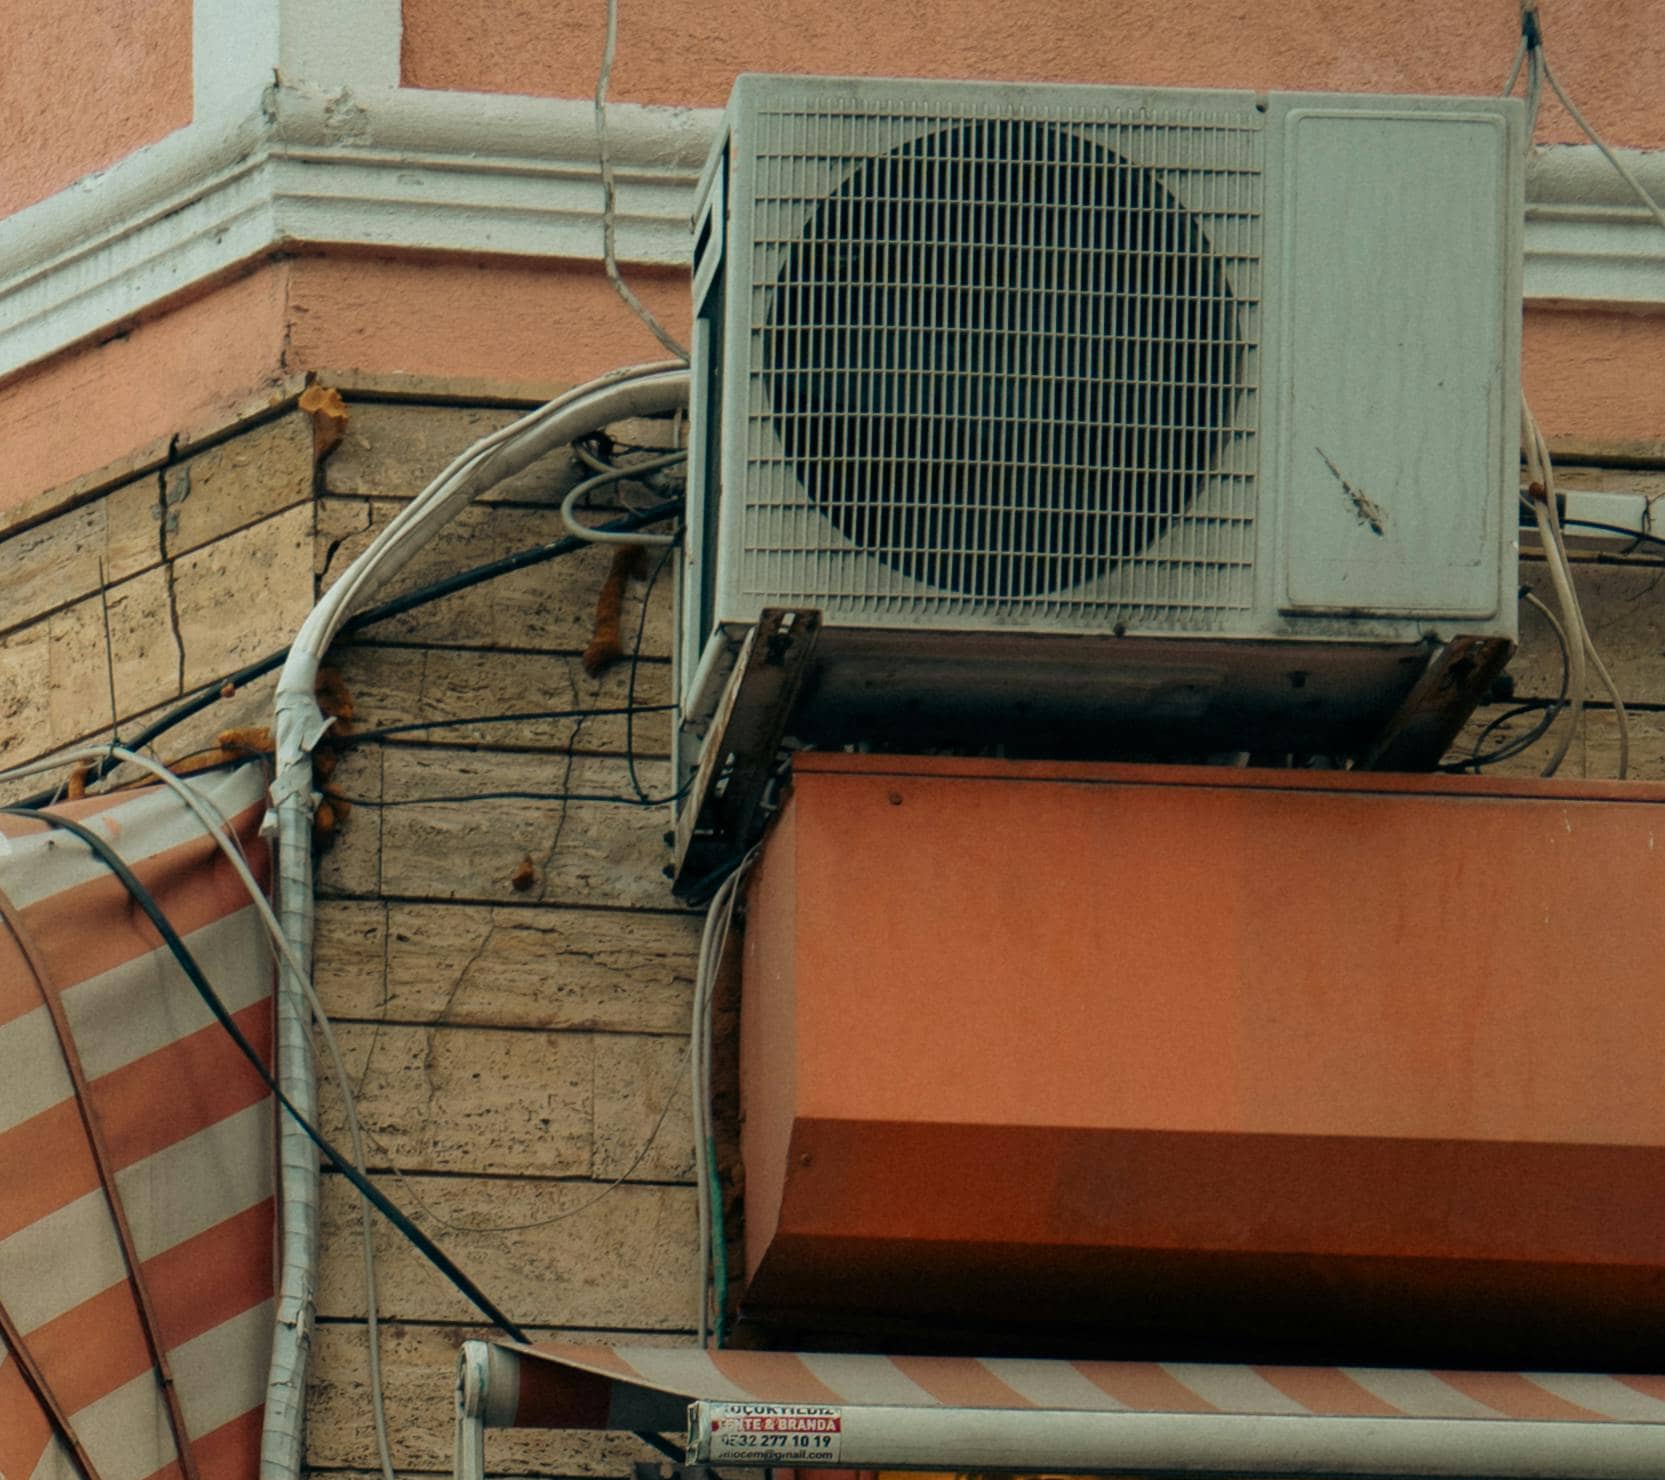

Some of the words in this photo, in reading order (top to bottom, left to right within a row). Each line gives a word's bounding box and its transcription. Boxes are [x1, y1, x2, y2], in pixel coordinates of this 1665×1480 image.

[780, 1419, 836, 1431] BRANDA
[761, 1435, 787, 1447] 277
[792, 1435, 809, 1447] 10
[815, 1436, 831, 1447] 19
